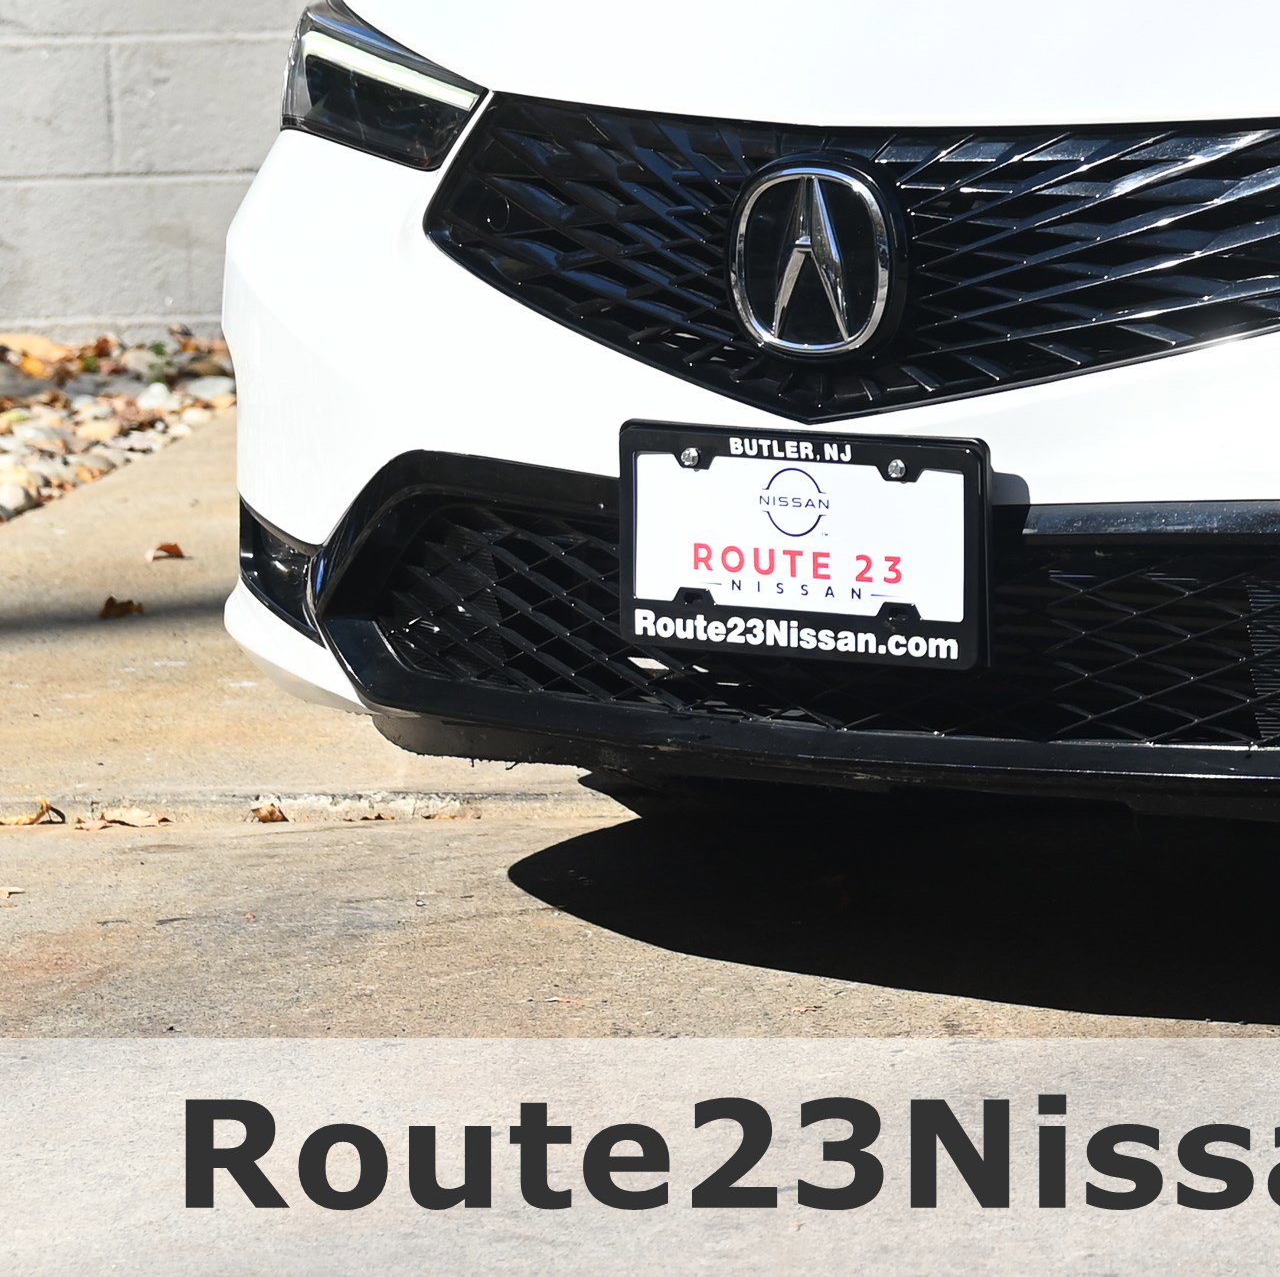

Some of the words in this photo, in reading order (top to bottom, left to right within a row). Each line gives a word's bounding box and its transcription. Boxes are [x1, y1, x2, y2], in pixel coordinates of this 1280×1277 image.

[729, 437, 821, 461] BUTLER,
[823, 443, 852, 462] NJ
[759, 495, 830, 509] NISSAN
[693, 542, 832, 580] ROUTE
[855, 554, 903, 584] 23
[731, 579, 862, 600] NISSAN
[634, 608, 960, 660] Route23Nissan.com
